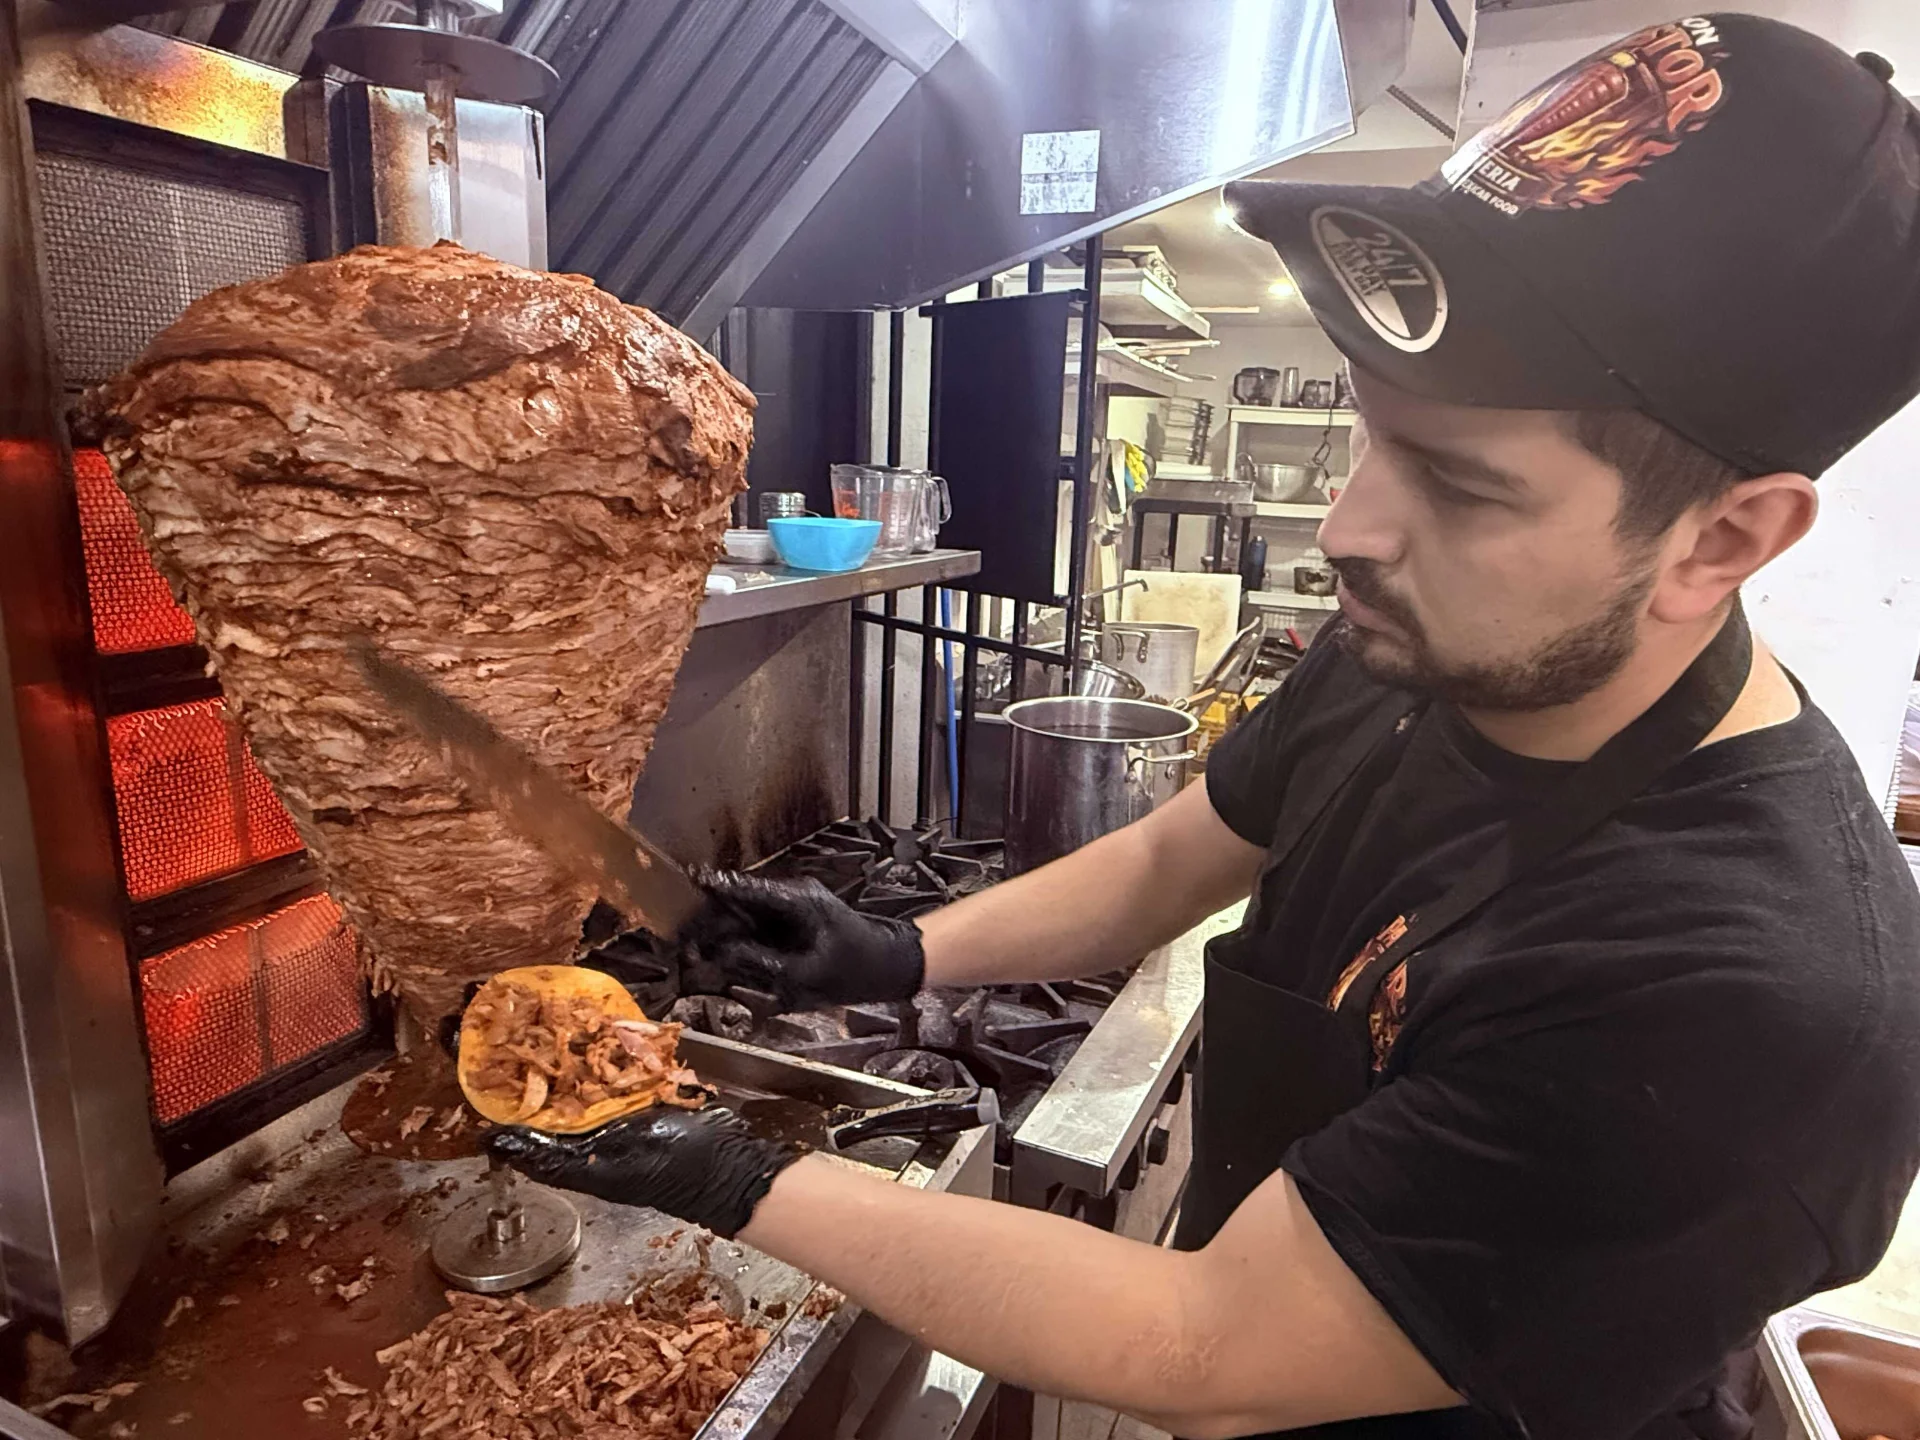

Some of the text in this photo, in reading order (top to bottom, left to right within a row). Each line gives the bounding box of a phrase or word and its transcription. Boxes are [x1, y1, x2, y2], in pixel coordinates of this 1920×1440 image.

[1479, 160, 1521, 191] ERIA
[1488, 196, 1519, 215] FOOD
[1353, 232, 1429, 286] 24/7
